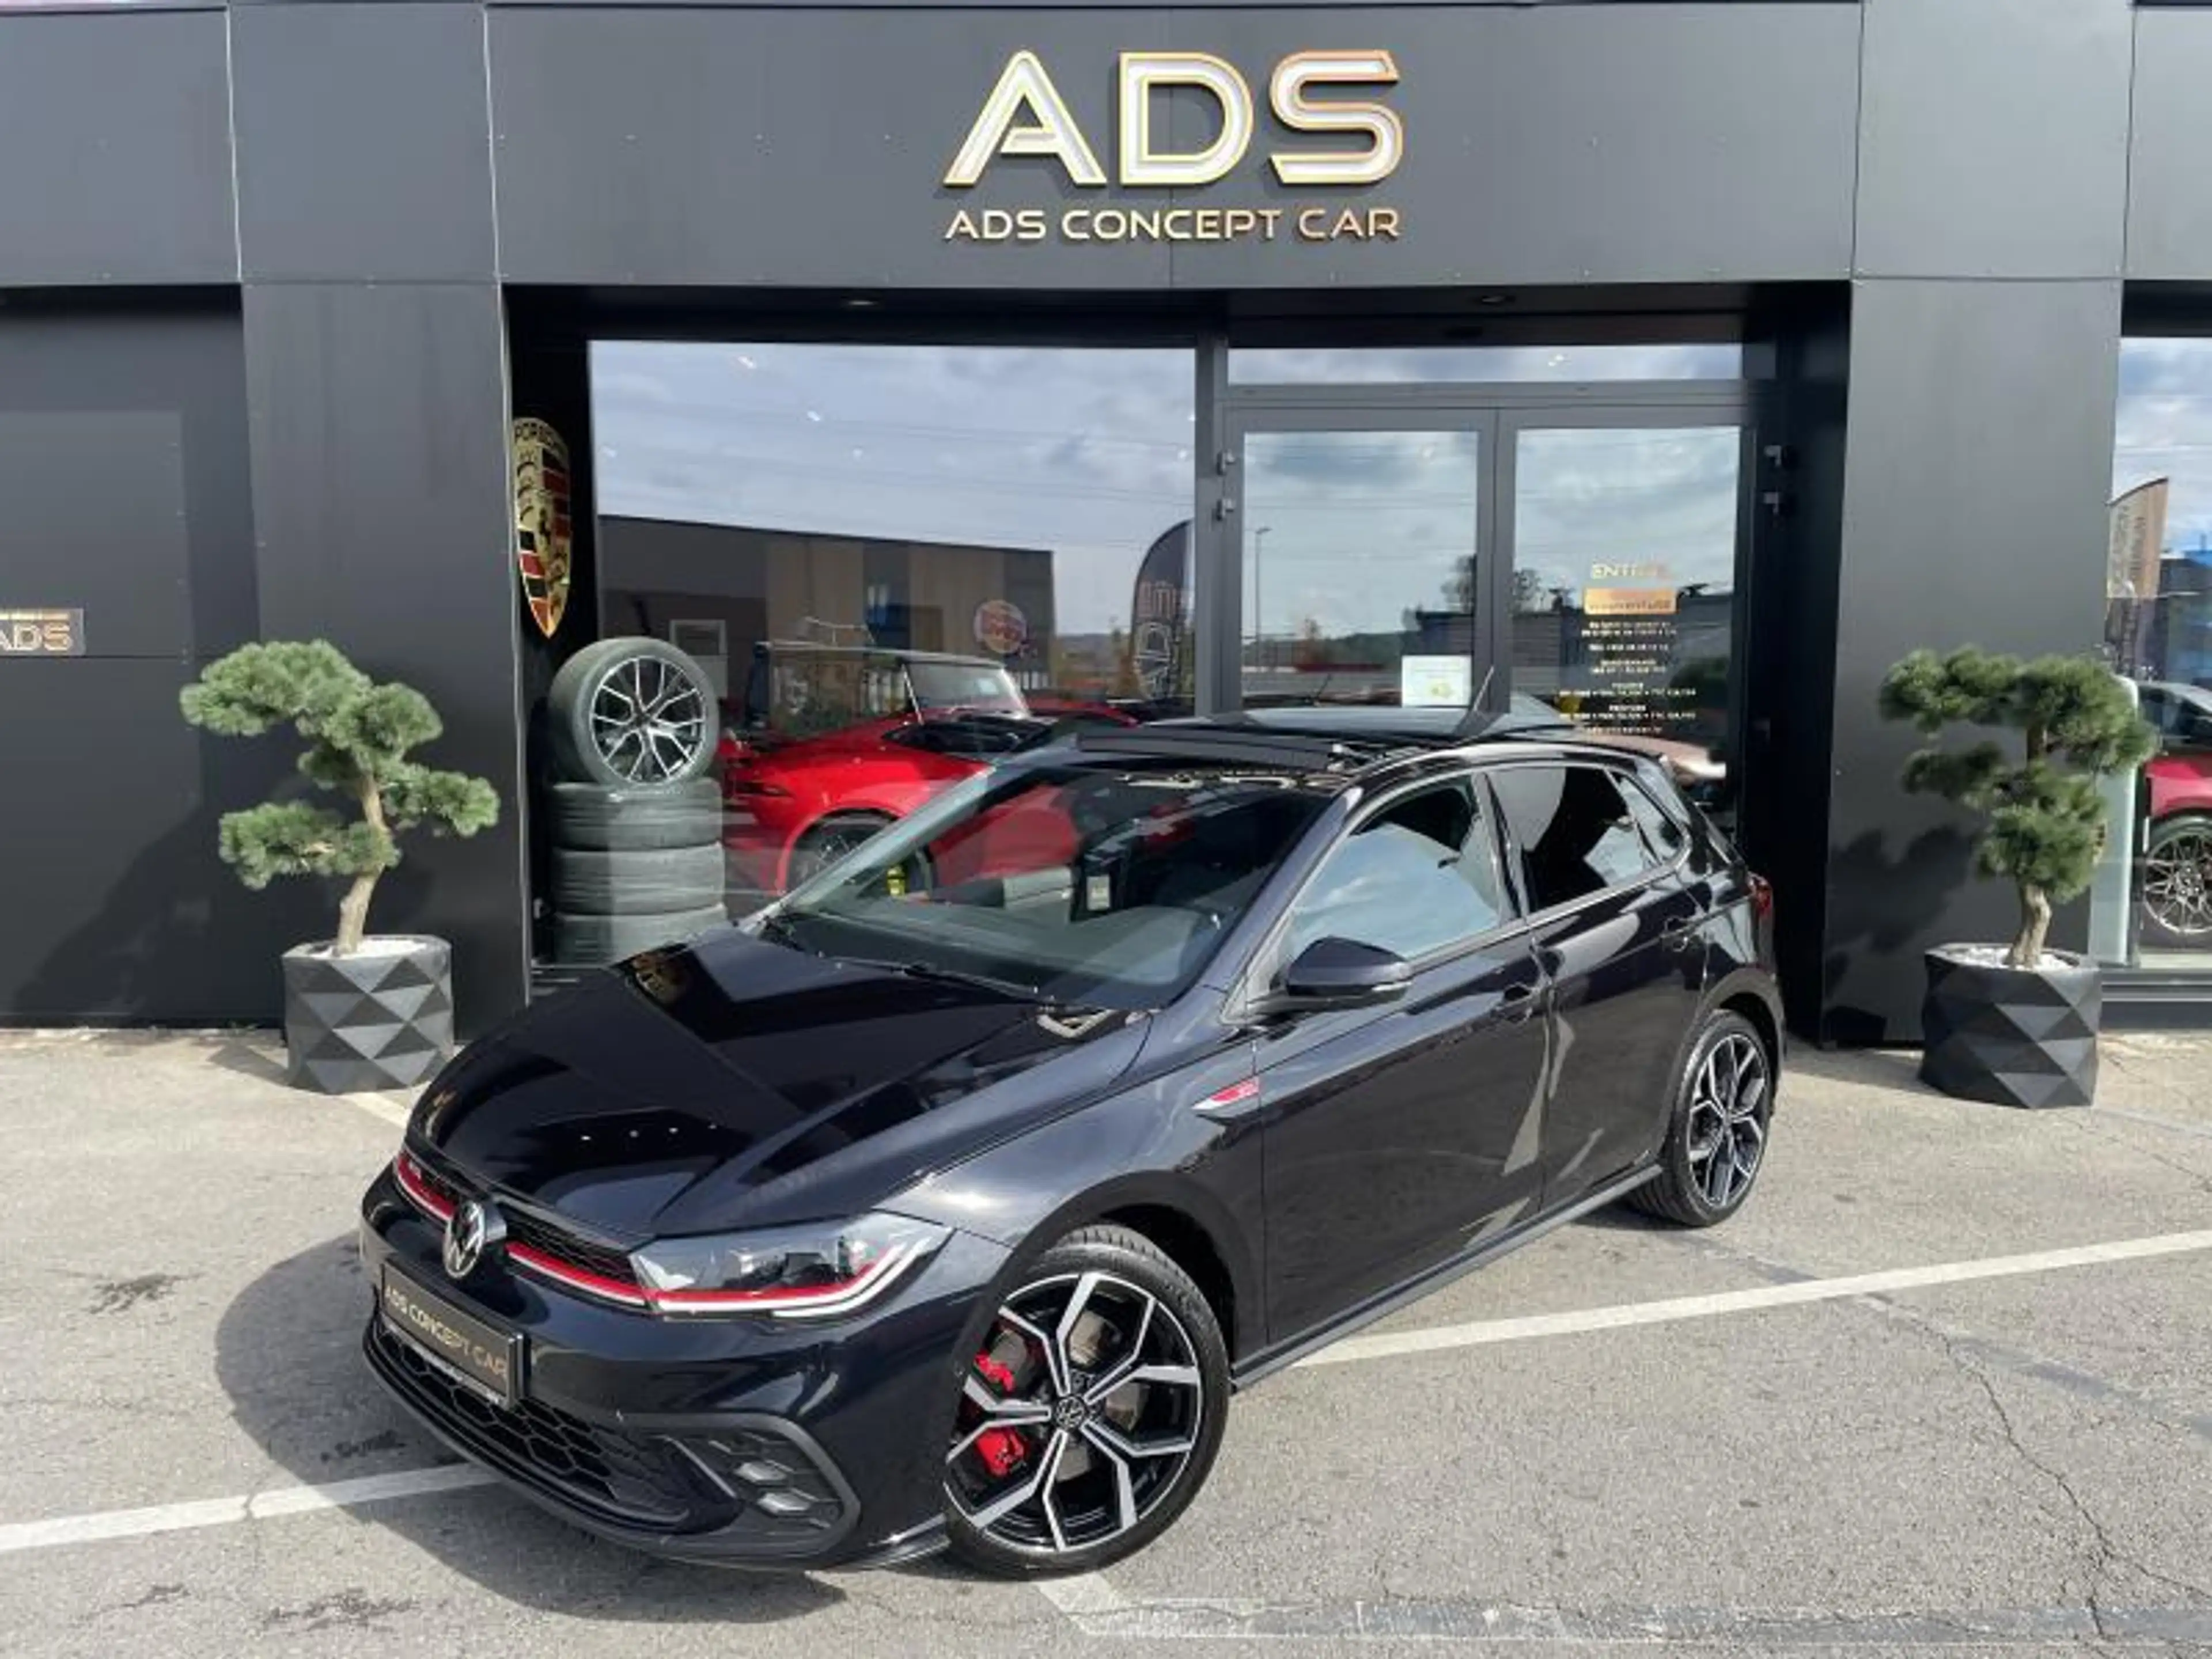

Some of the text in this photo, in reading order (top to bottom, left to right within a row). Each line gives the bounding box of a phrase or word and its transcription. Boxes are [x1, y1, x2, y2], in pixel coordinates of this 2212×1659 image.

[943, 49, 1404, 187] ADS
[945, 208, 1402, 240] ADS CONCEPT CAR
